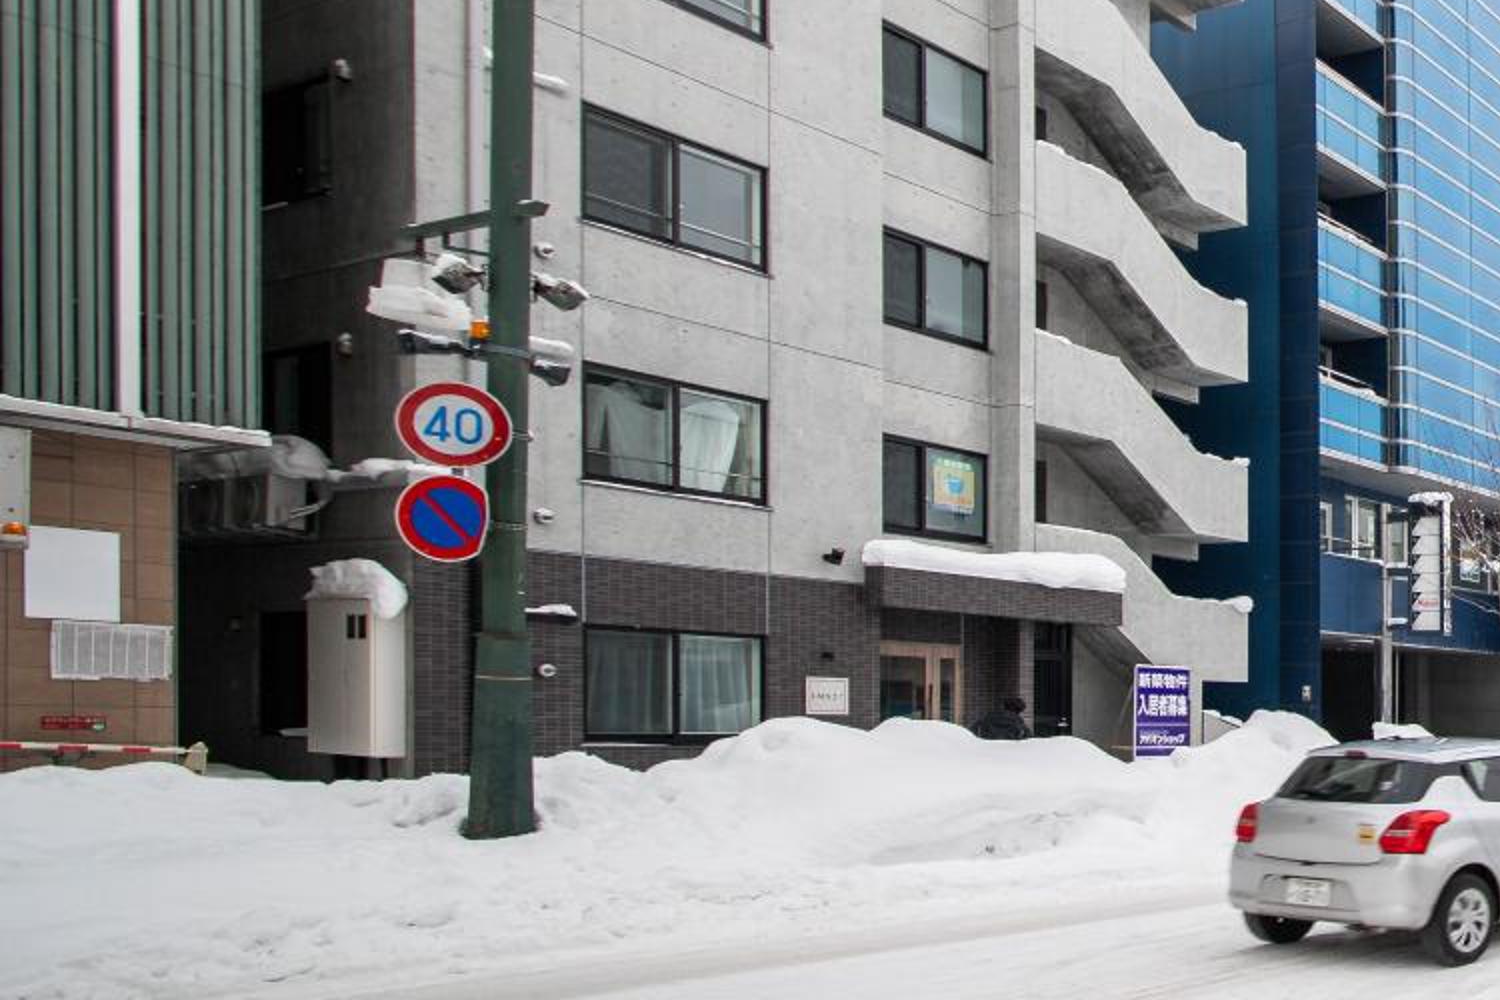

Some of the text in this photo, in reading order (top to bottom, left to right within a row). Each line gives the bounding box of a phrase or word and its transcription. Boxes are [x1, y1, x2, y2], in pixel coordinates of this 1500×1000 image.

[423, 405, 483, 445] 40
[1138, 672, 1187, 689] 新築物件
[1137, 693, 1188, 716] 入居者募集
